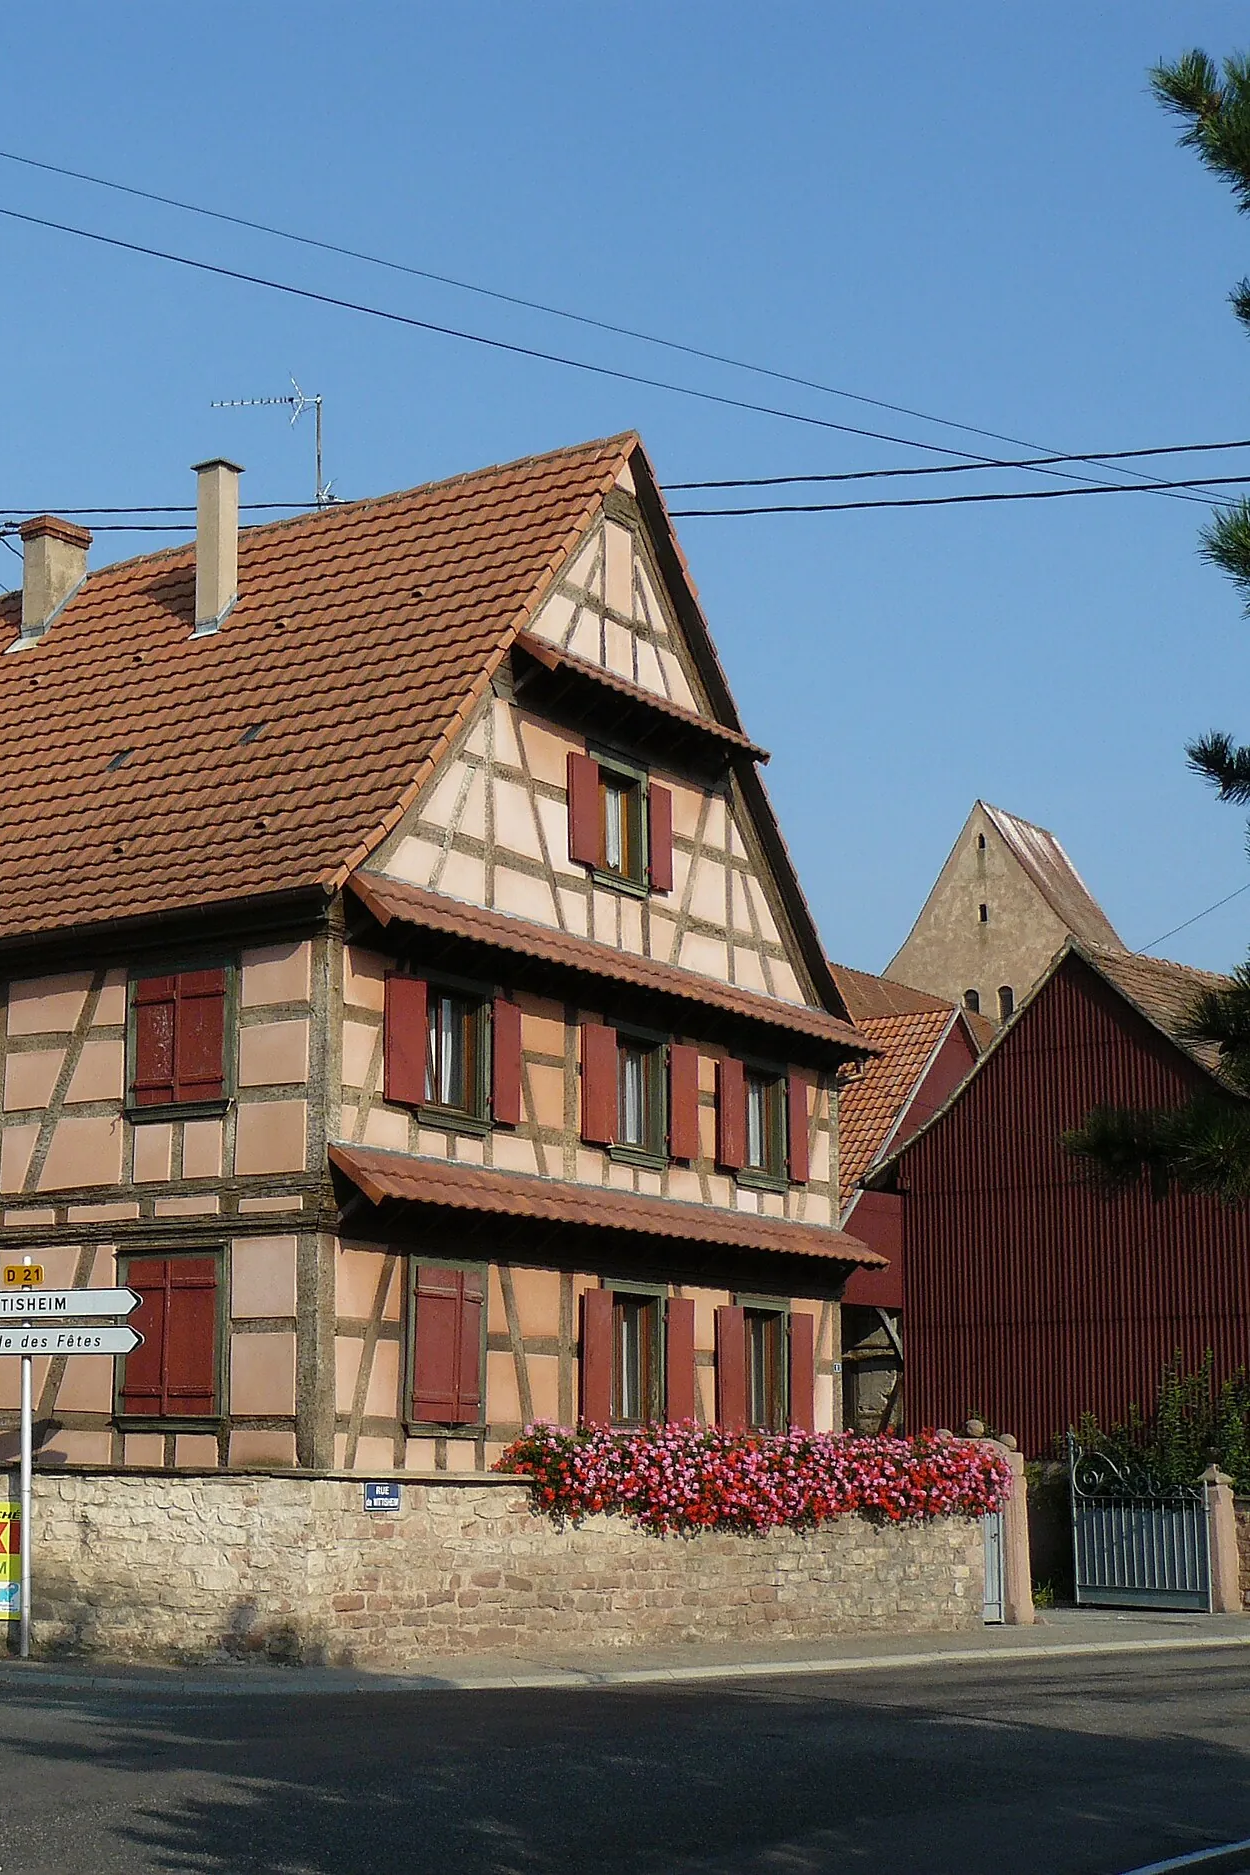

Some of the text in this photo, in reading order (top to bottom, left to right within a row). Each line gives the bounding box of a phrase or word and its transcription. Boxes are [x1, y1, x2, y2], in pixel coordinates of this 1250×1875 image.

[7, 1269, 40, 1282] D 21
[21, 1335, 48, 1348] des
[56, 1334, 102, 1348] Fêtes
[375, 1486, 390, 1495] RUE
